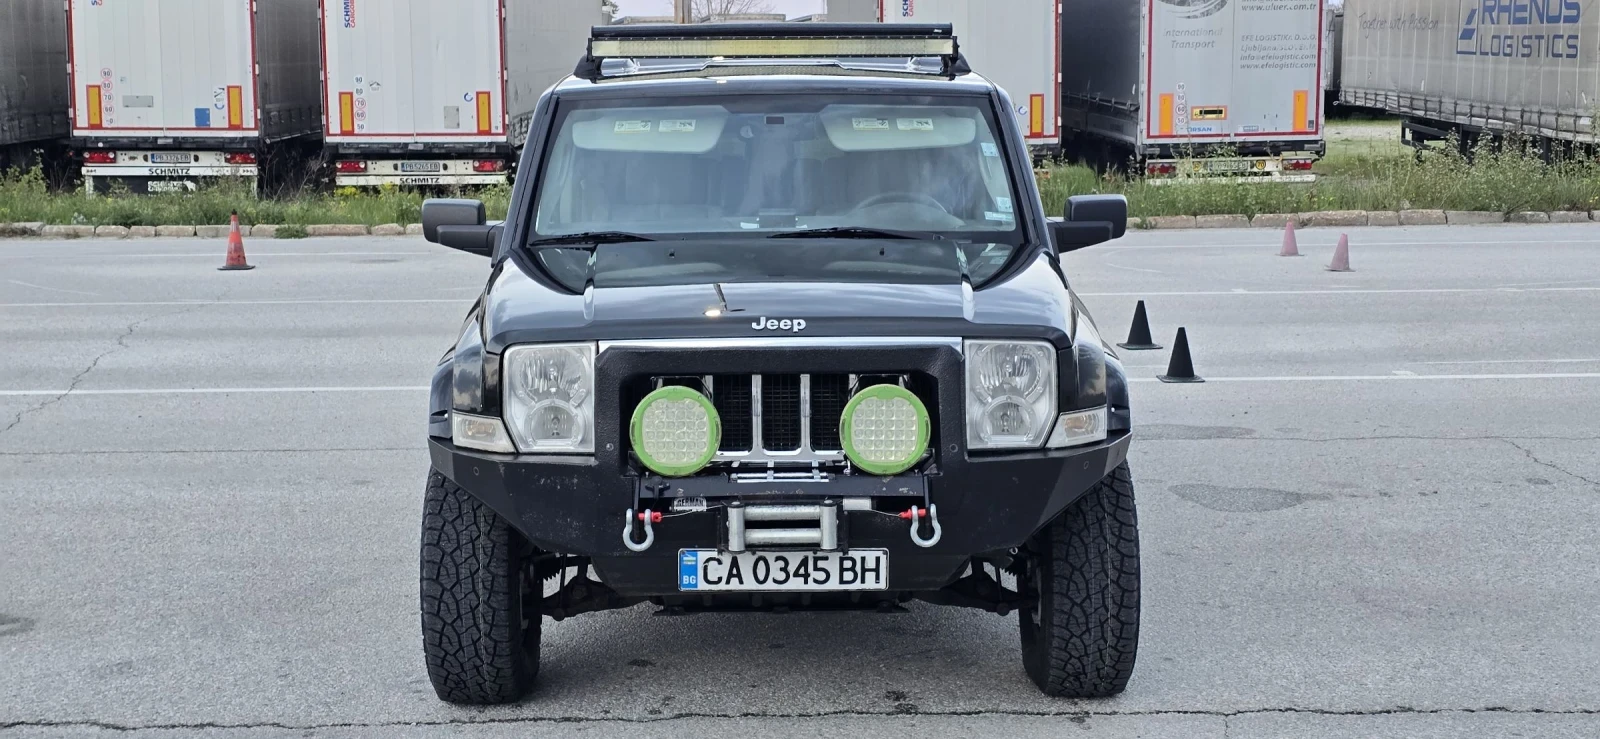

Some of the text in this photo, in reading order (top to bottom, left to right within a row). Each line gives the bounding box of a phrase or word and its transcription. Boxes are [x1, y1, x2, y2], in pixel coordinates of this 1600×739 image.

[1389, 12, 1406, 30] with
[1482, 0, 1580, 25] RHENUS
[1171, 40, 1215, 50] Transport
[1479, 34, 1579, 59] LOGISTICS
[751, 316, 806, 333] Jeep
[703, 555, 881, 585] CA 0345 BH
[683, 575, 696, 584] BG
